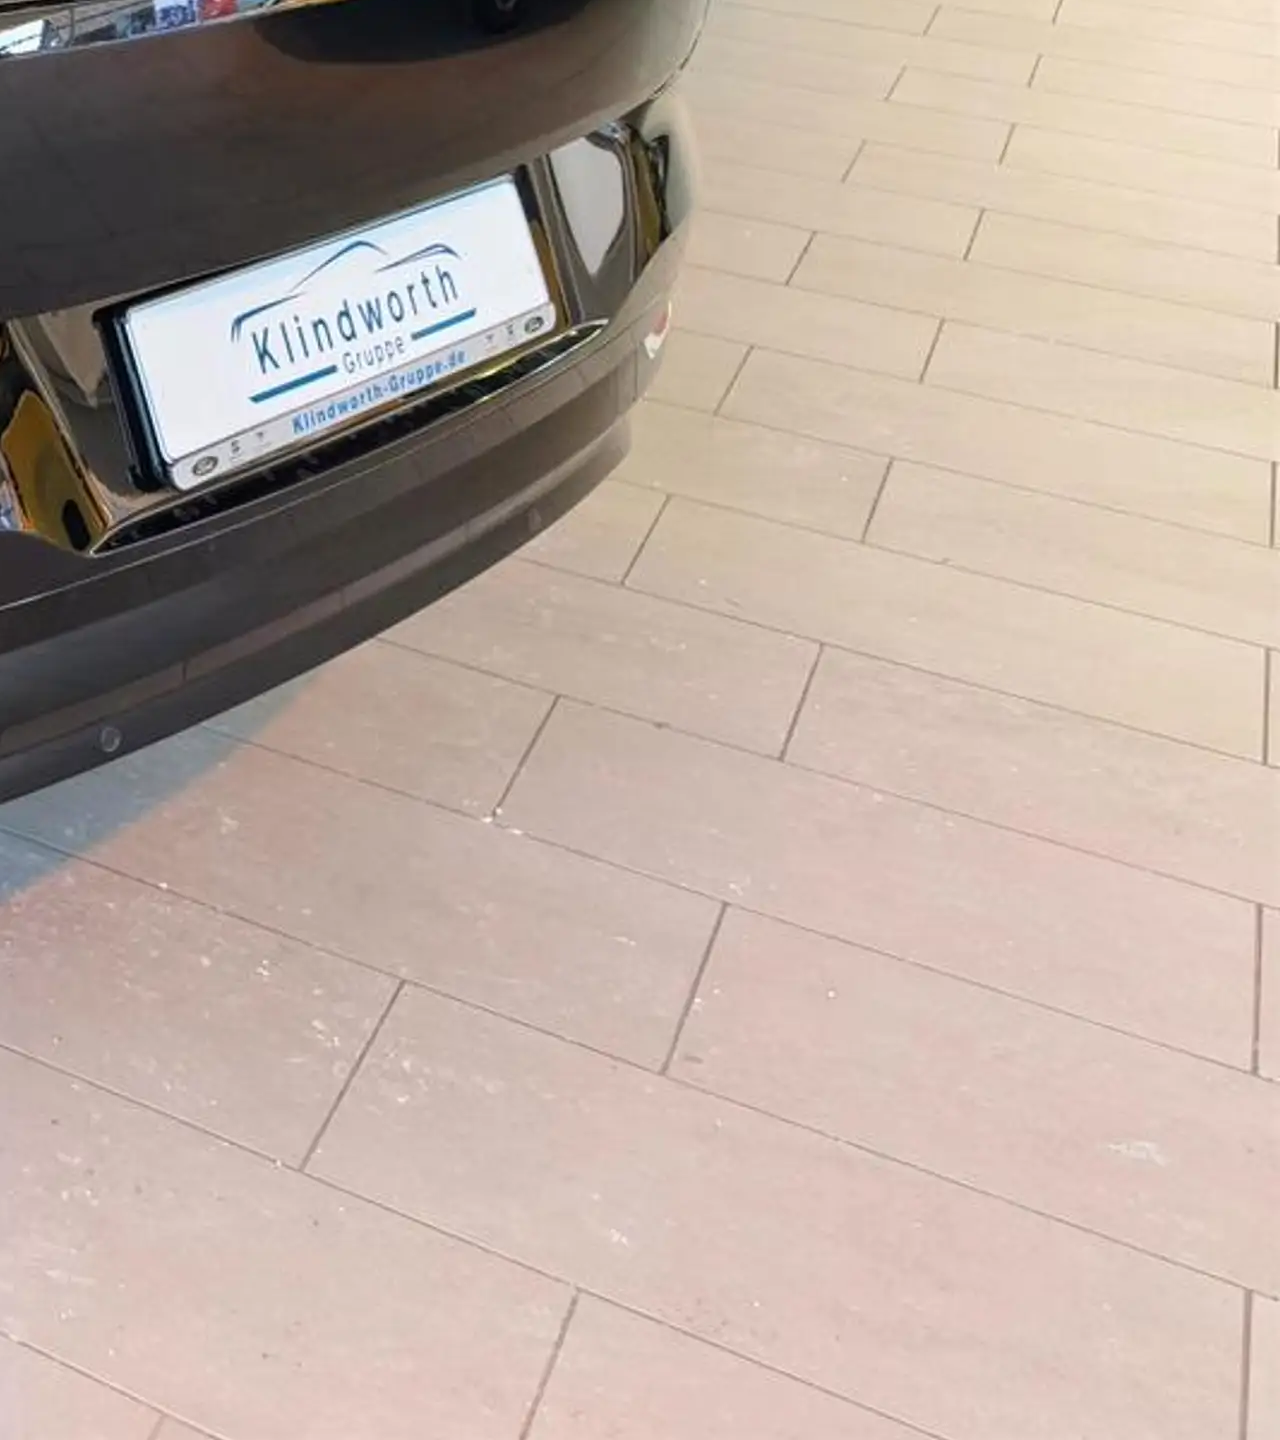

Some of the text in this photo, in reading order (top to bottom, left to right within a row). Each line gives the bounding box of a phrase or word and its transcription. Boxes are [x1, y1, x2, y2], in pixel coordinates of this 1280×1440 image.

[251, 264, 459, 375] Klindworth
[342, 335, 407, 375] Gruppe
[292, 349, 468, 435] Klindworth-Gruppe.de
